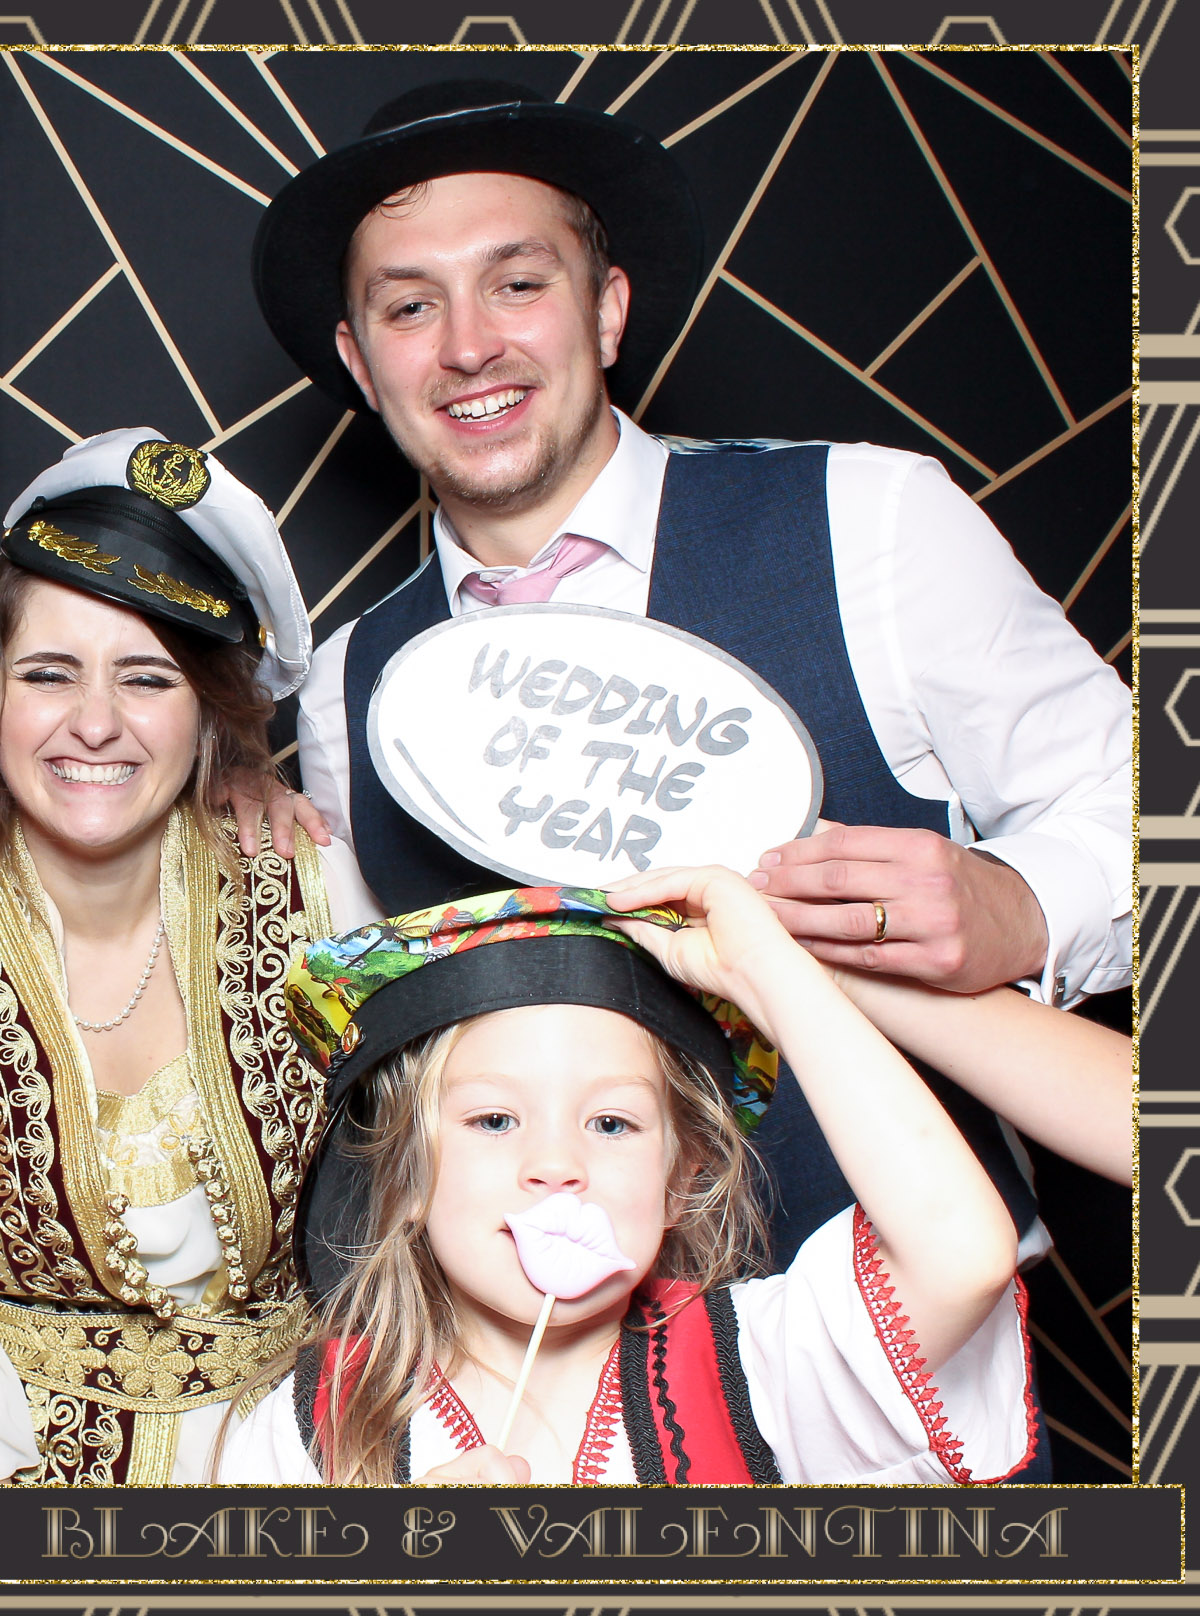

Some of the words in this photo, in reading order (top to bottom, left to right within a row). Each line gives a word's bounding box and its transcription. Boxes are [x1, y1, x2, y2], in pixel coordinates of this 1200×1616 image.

[468, 642, 753, 756] WEDDING
[482, 715, 562, 773] OF
[581, 740, 706, 813] THE
[498, 785, 663, 873] YEAR
